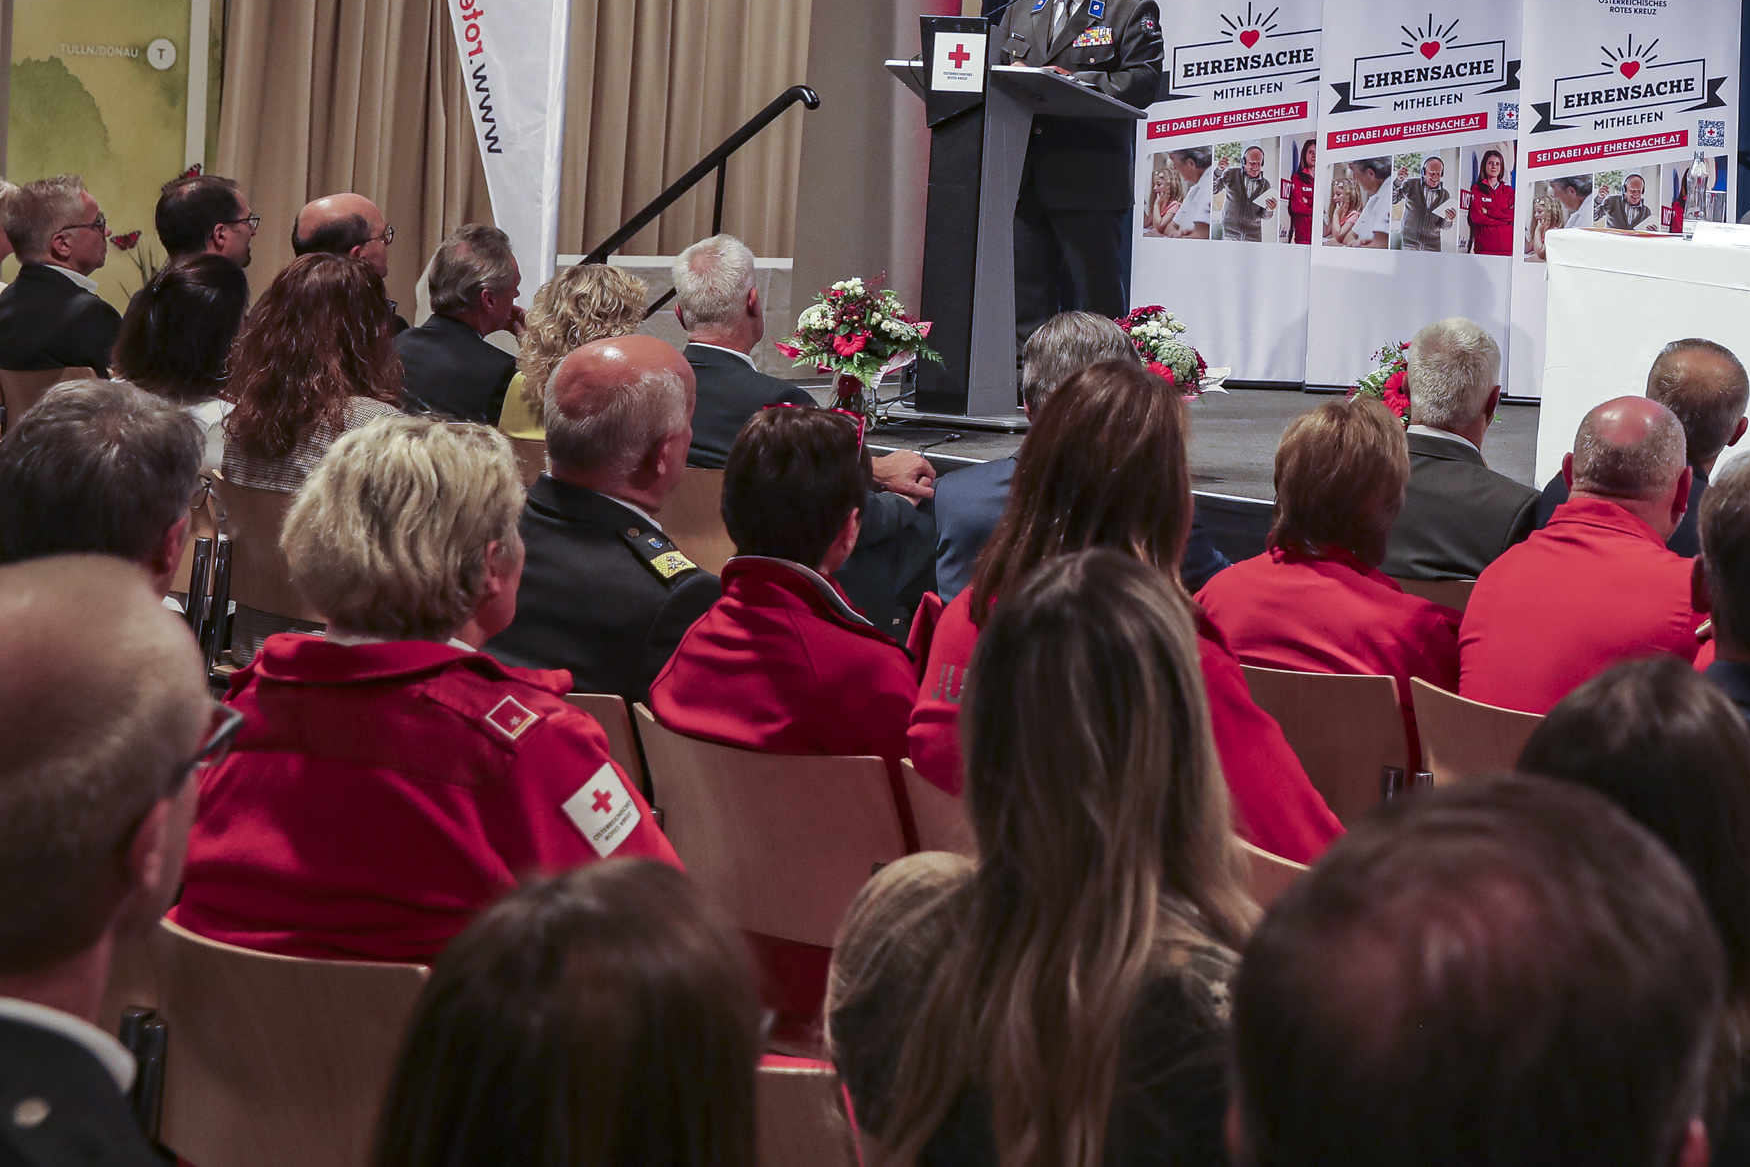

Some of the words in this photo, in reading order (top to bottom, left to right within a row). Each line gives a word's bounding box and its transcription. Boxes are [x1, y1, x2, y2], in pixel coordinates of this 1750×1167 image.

[1609, 6, 1632, 14] ROTES
[1634, 7, 1657, 15] KREUZ
[157, 48, 166, 60] T
[1182, 48, 1314, 78] EHRENSACHE
[1363, 59, 1495, 89] EHRENSACHE
[1213, 81, 1283, 100] MITHELFEN
[1393, 93, 1463, 111] MITHELFEN
[1563, 77, 1695, 109] EHRENSACHE
[1155, 122, 1170, 133] SEI
[1172, 119, 1201, 131] DABEI
[1202, 116, 1222, 126] AUF
[1223, 105, 1300, 124] EHRENSACHE.AT
[1335, 133, 1350, 143] SEI
[1352, 130, 1381, 141] DABEI
[1382, 126, 1402, 137] AUF
[1403, 116, 1480, 135] EHRENSACHE.AT
[1594, 111, 1664, 130] MITHELFEN
[1536, 152, 1551, 162] SEI
[1553, 149, 1581, 160] DABEI
[1583, 146, 1602, 156] AUF
[1603, 134, 1681, 153] EHRENSACHE.AT
